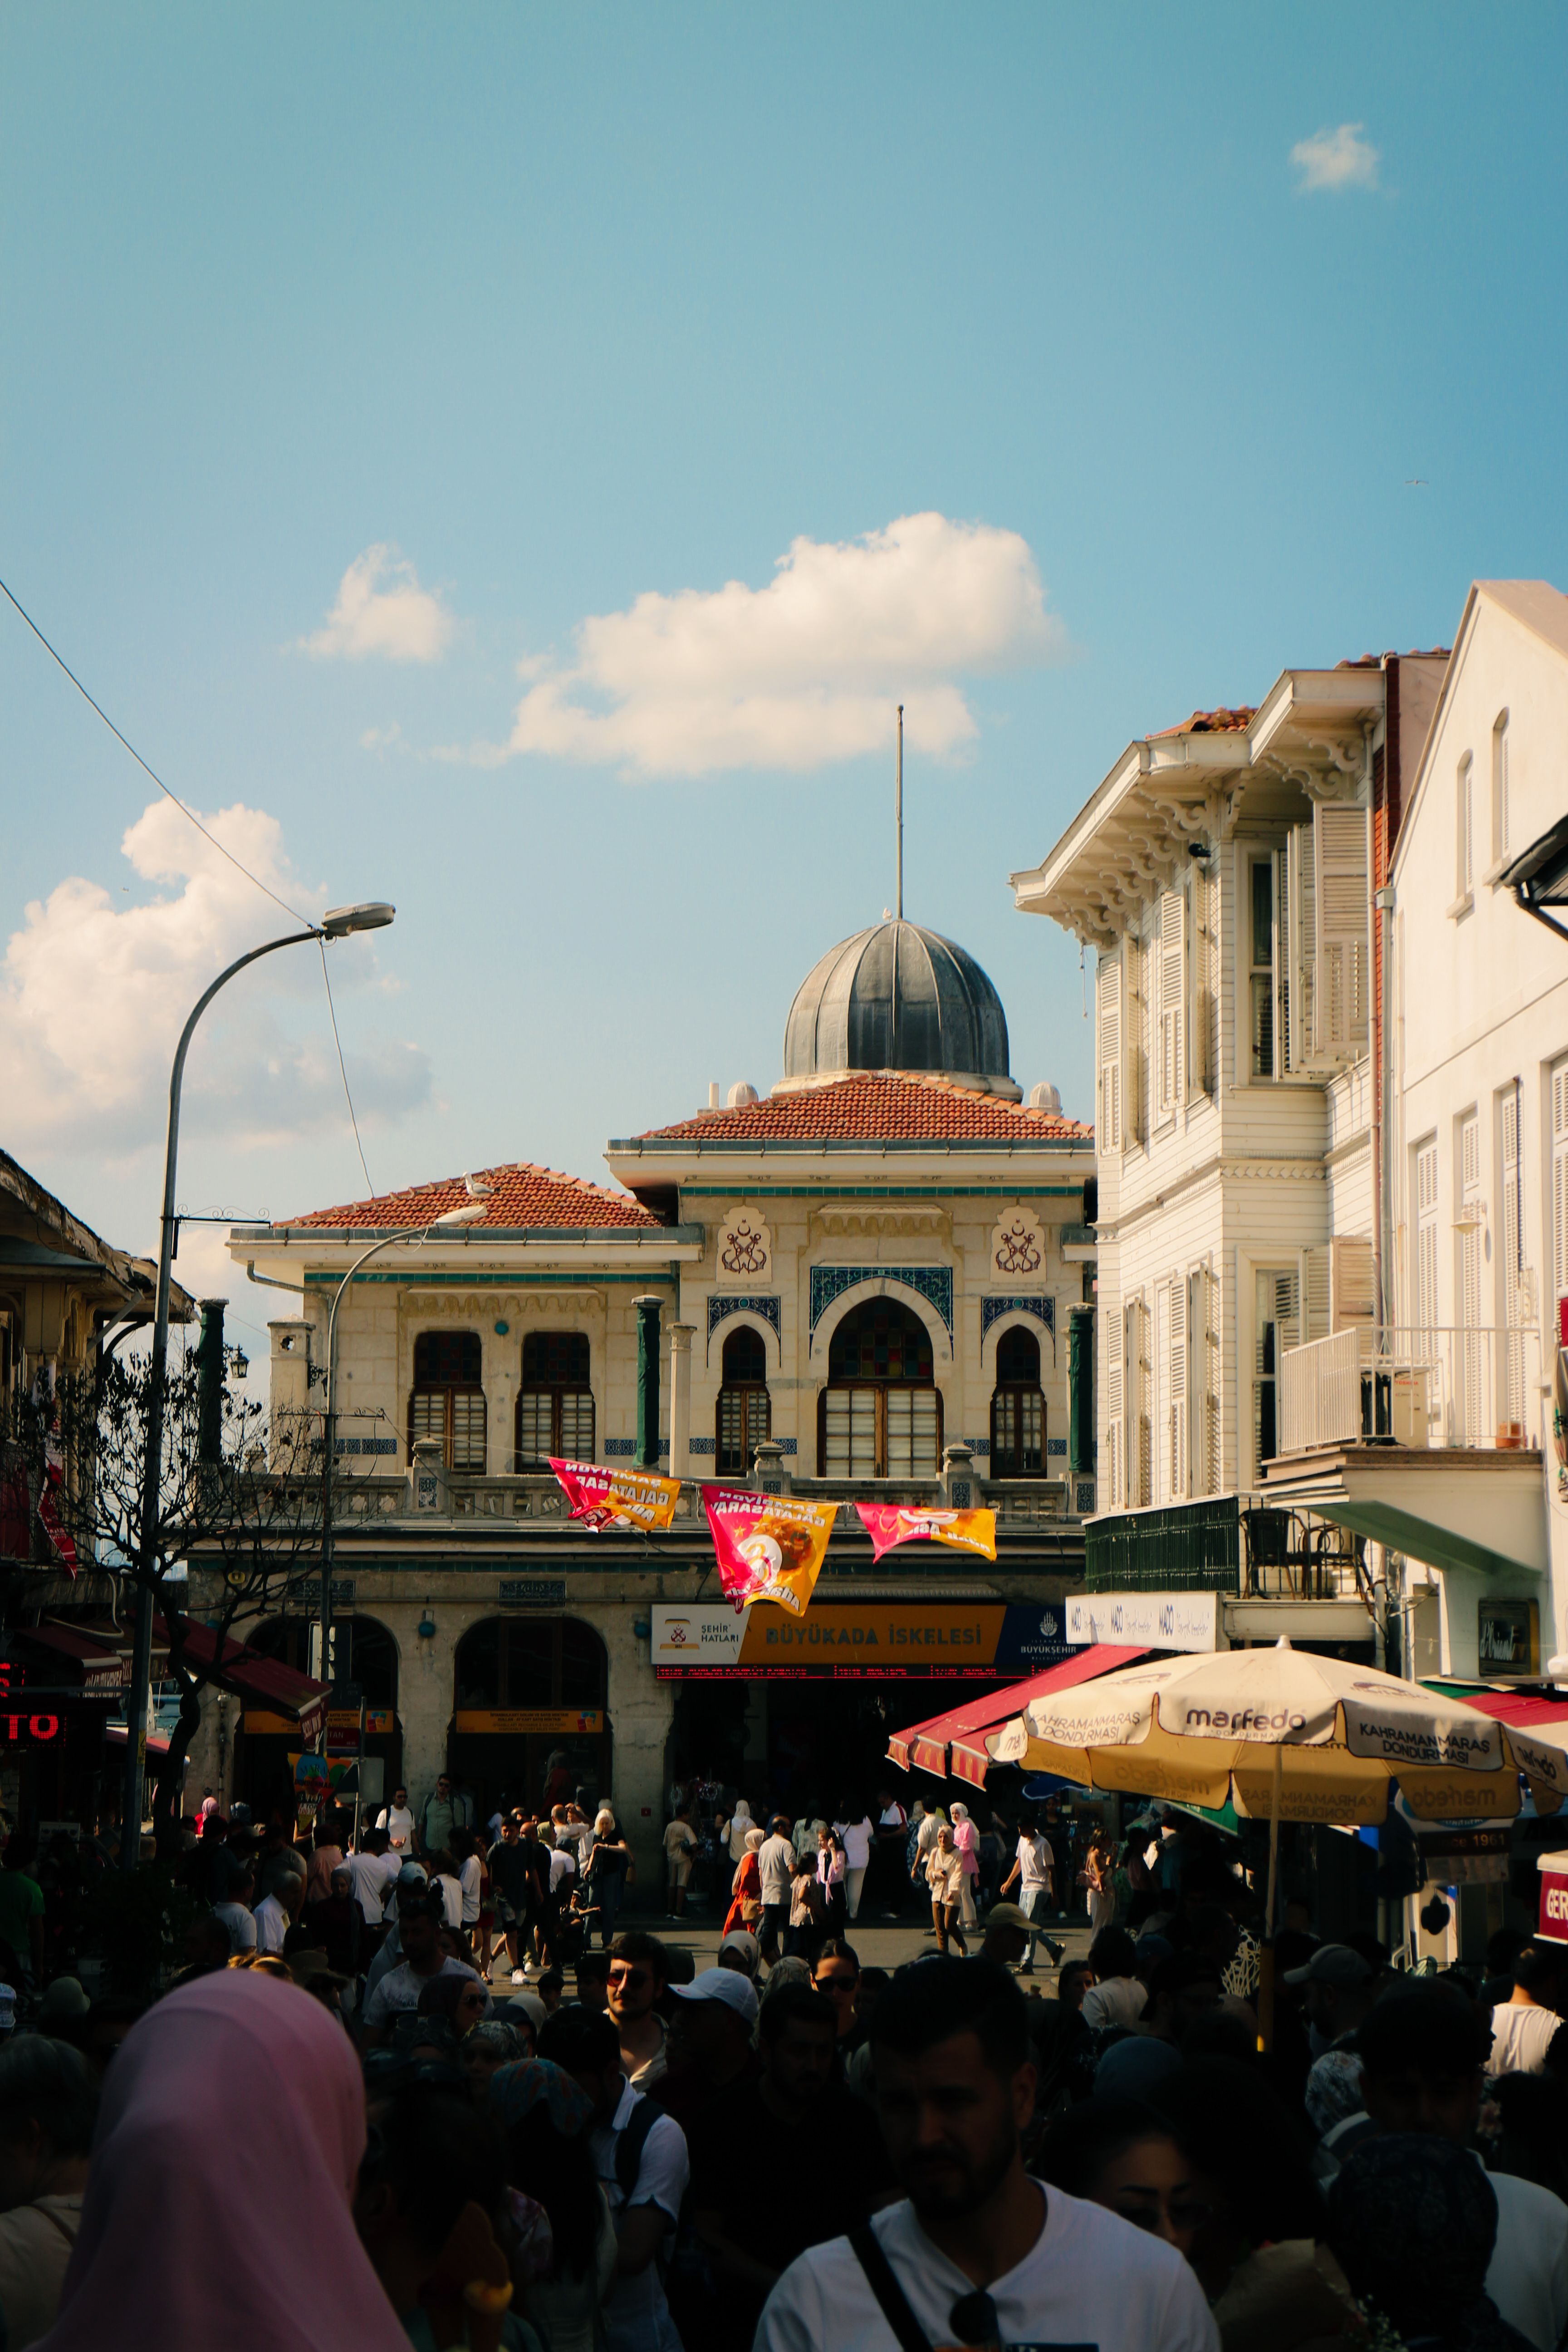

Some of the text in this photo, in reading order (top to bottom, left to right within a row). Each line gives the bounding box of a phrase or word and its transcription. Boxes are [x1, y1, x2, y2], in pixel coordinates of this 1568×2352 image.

[701, 1622, 728, 1634] ŞEHİR
[1071, 1606, 1082, 1633] MADO
[1111, 1604, 1123, 1635] MADO
[1159, 1604, 1174, 1637] MADO
[766, 1623, 981, 1645] BÜYÜKADA İSKELESİ
[1021, 1644, 1076, 1655] BÜYÜKŞEHİR
[1029, 1712, 1141, 1730] KAHRAMANMARAŞ
[1186, 1709, 1306, 1731] marfedo
[1043, 1726, 1119, 1743] DONDURMASI
[1360, 1723, 1490, 1754] KAHRAMANMARAŞ
[1382, 1740, 1469, 1764] DONDURMASI
[1472, 1833, 1505, 1847] 1961
